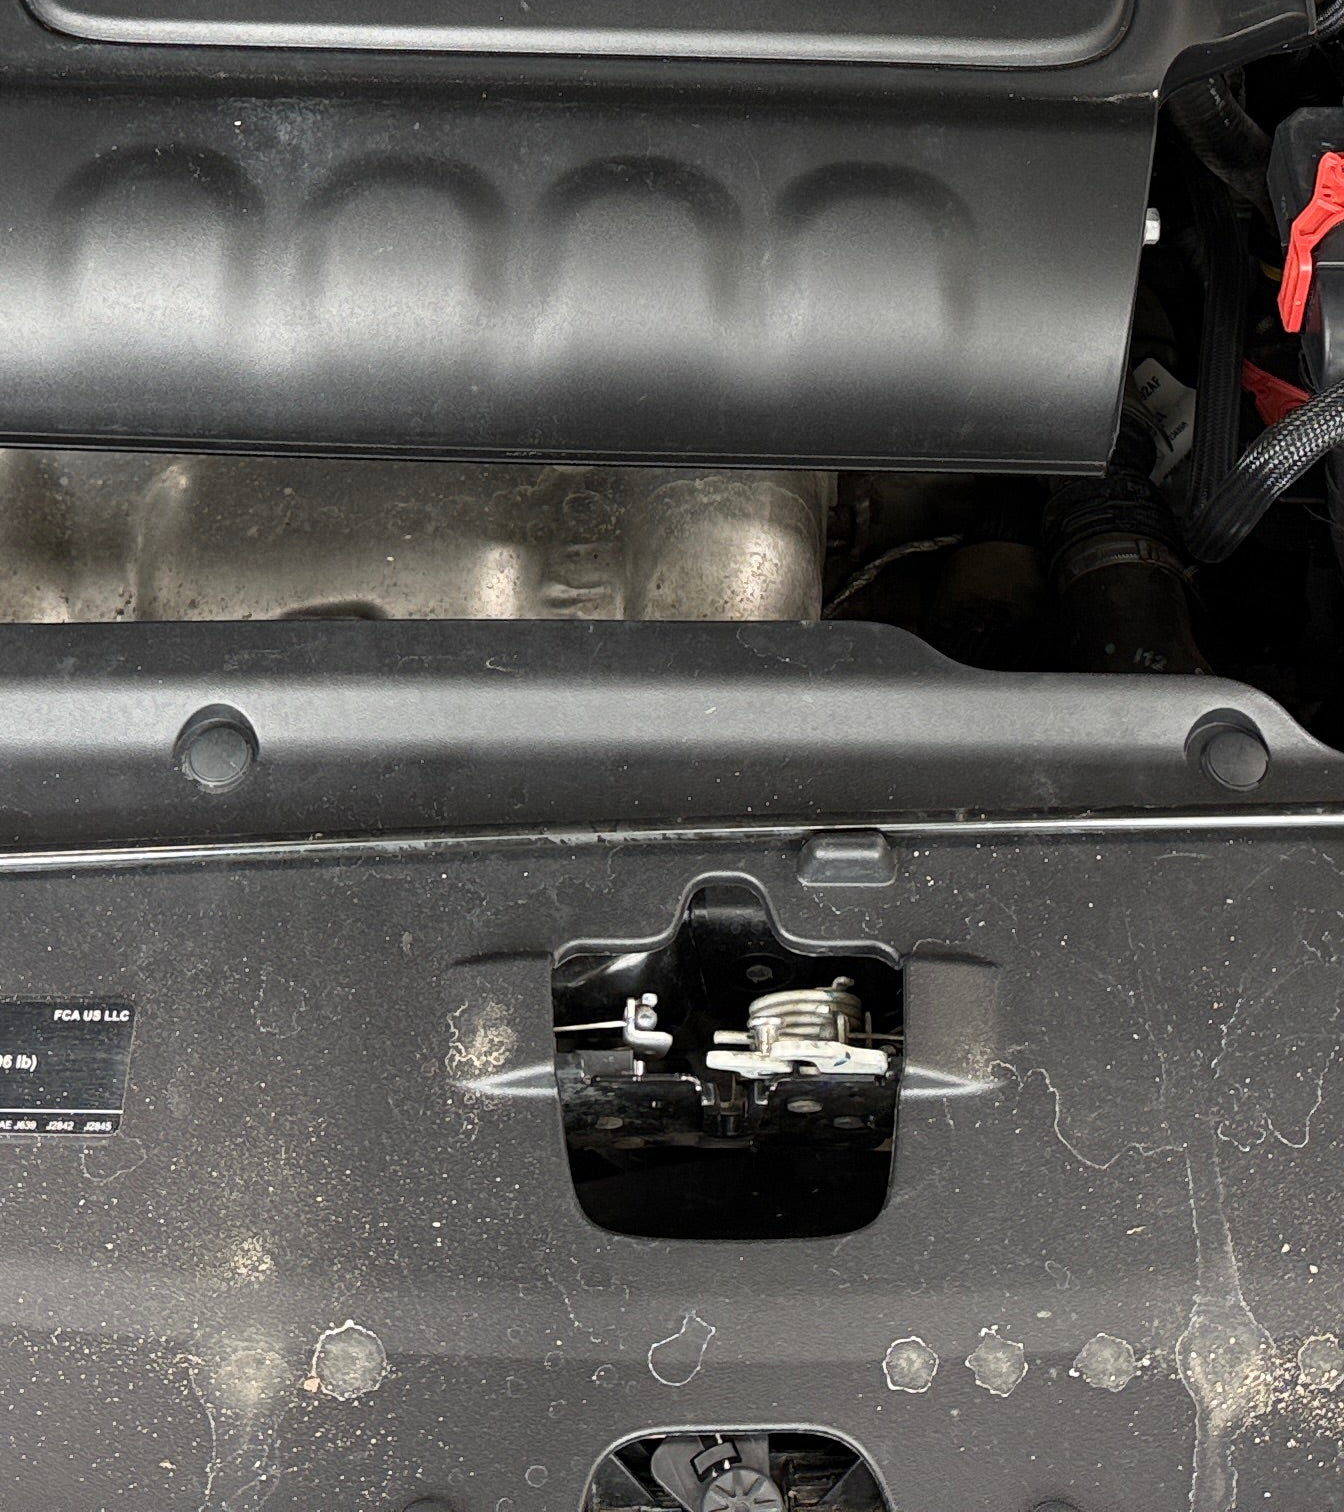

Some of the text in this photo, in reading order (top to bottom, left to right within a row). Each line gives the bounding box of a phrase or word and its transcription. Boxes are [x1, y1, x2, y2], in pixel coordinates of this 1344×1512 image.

[54, 1008, 130, 1023] FCA US LLC
[15, 1054, 38, 1073] lb)
